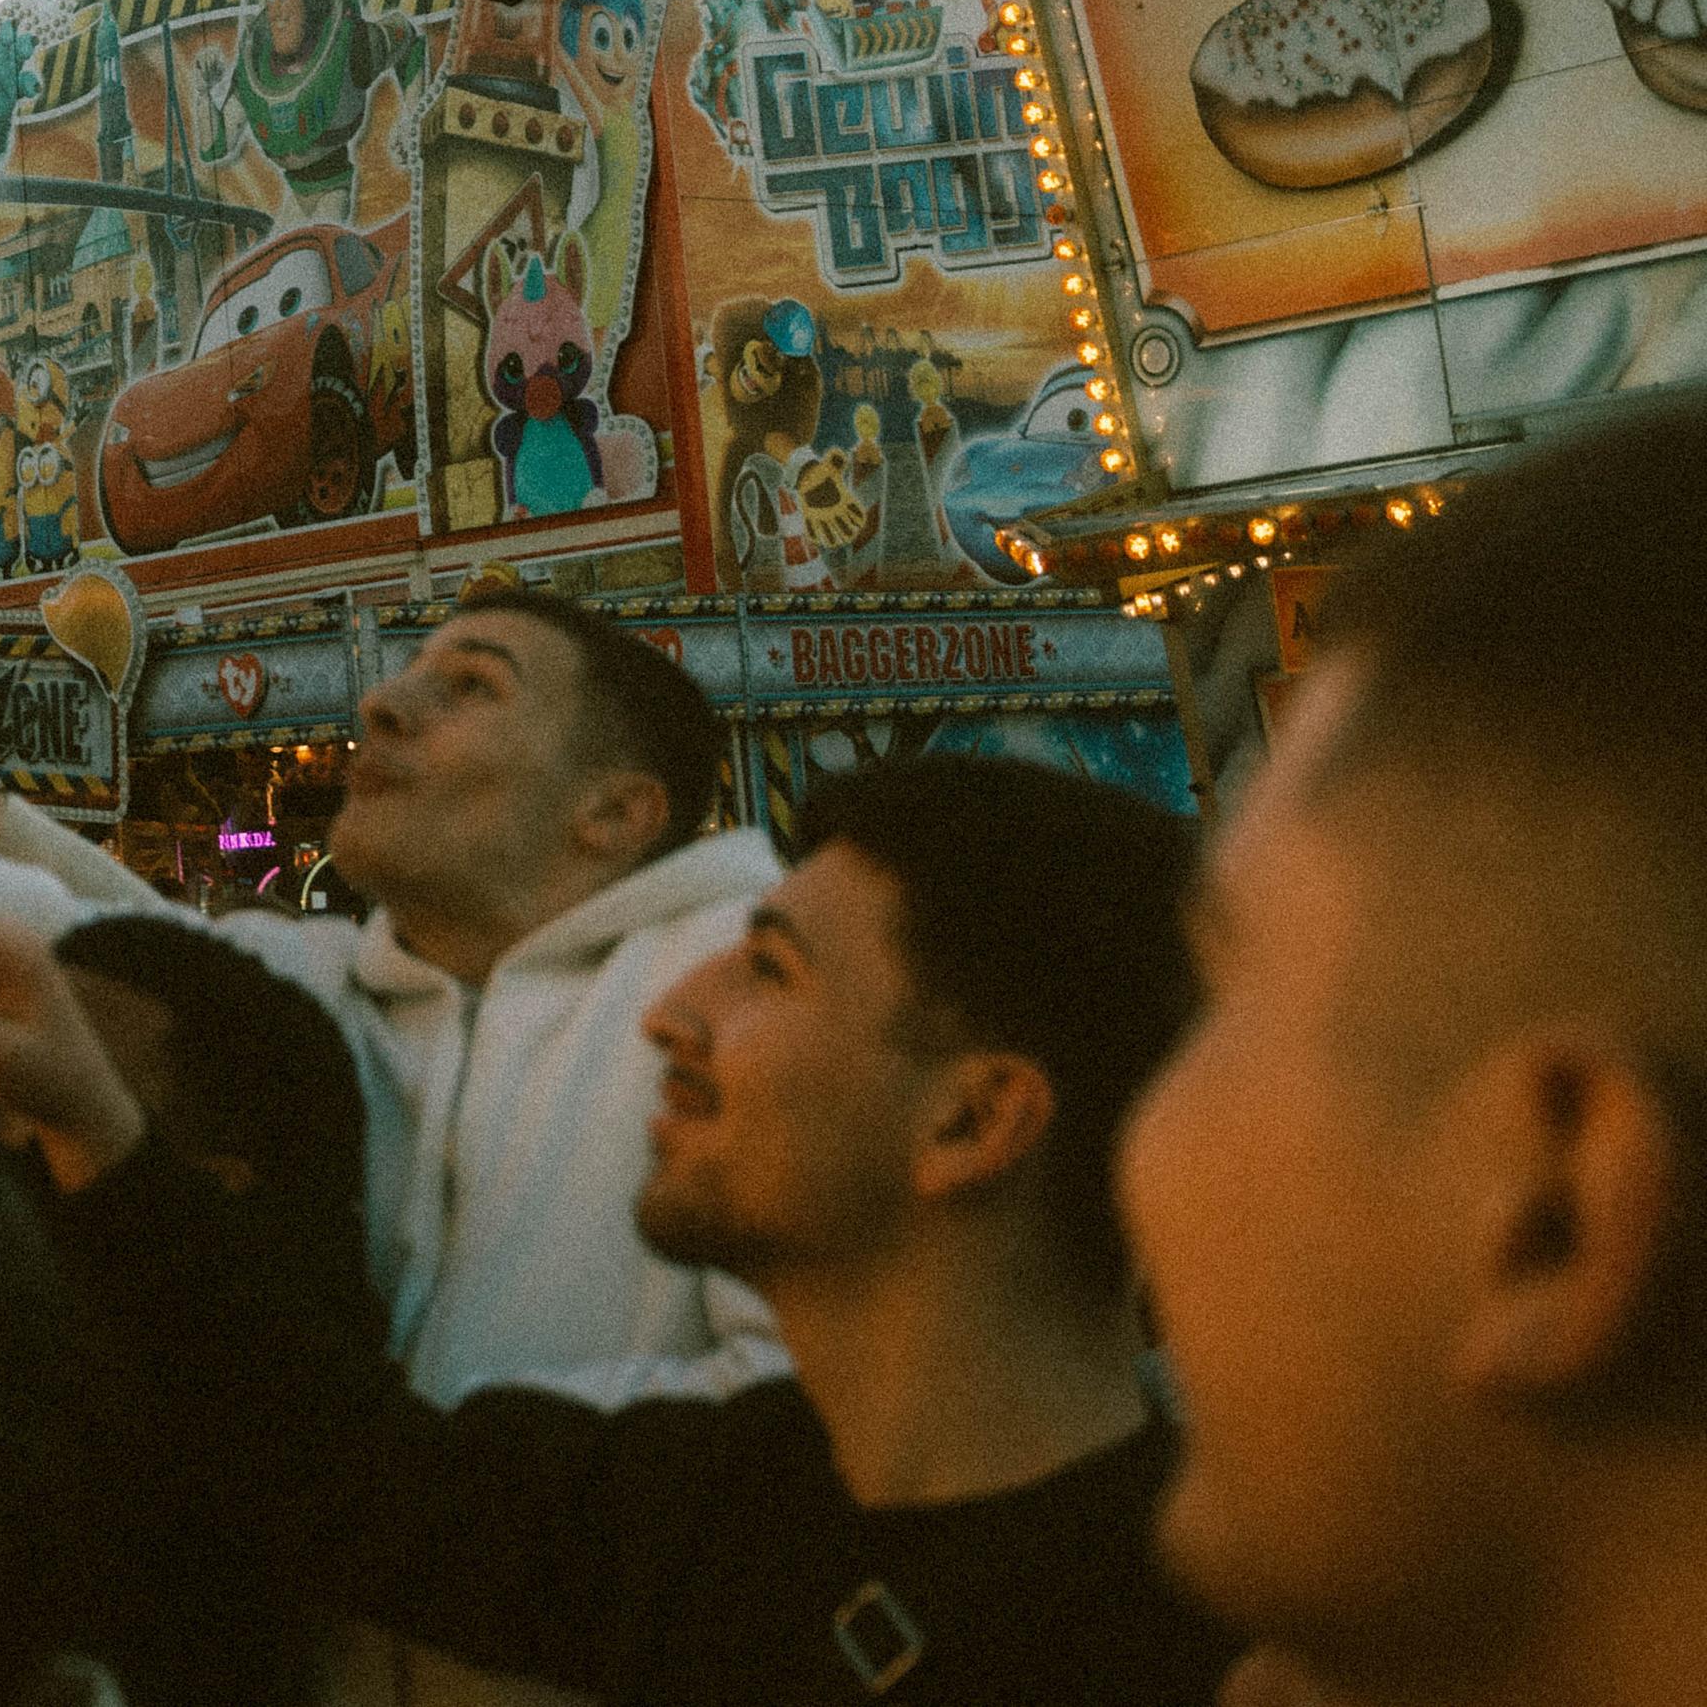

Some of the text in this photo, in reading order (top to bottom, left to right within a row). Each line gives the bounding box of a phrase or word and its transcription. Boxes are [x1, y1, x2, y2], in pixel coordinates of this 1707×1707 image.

[747, 47, 1035, 163] Gewin
[764, 151, 1055, 273] Bagg
[220, 657, 257, 706] ty
[790, 625, 1037, 684] BAGGERZONE
